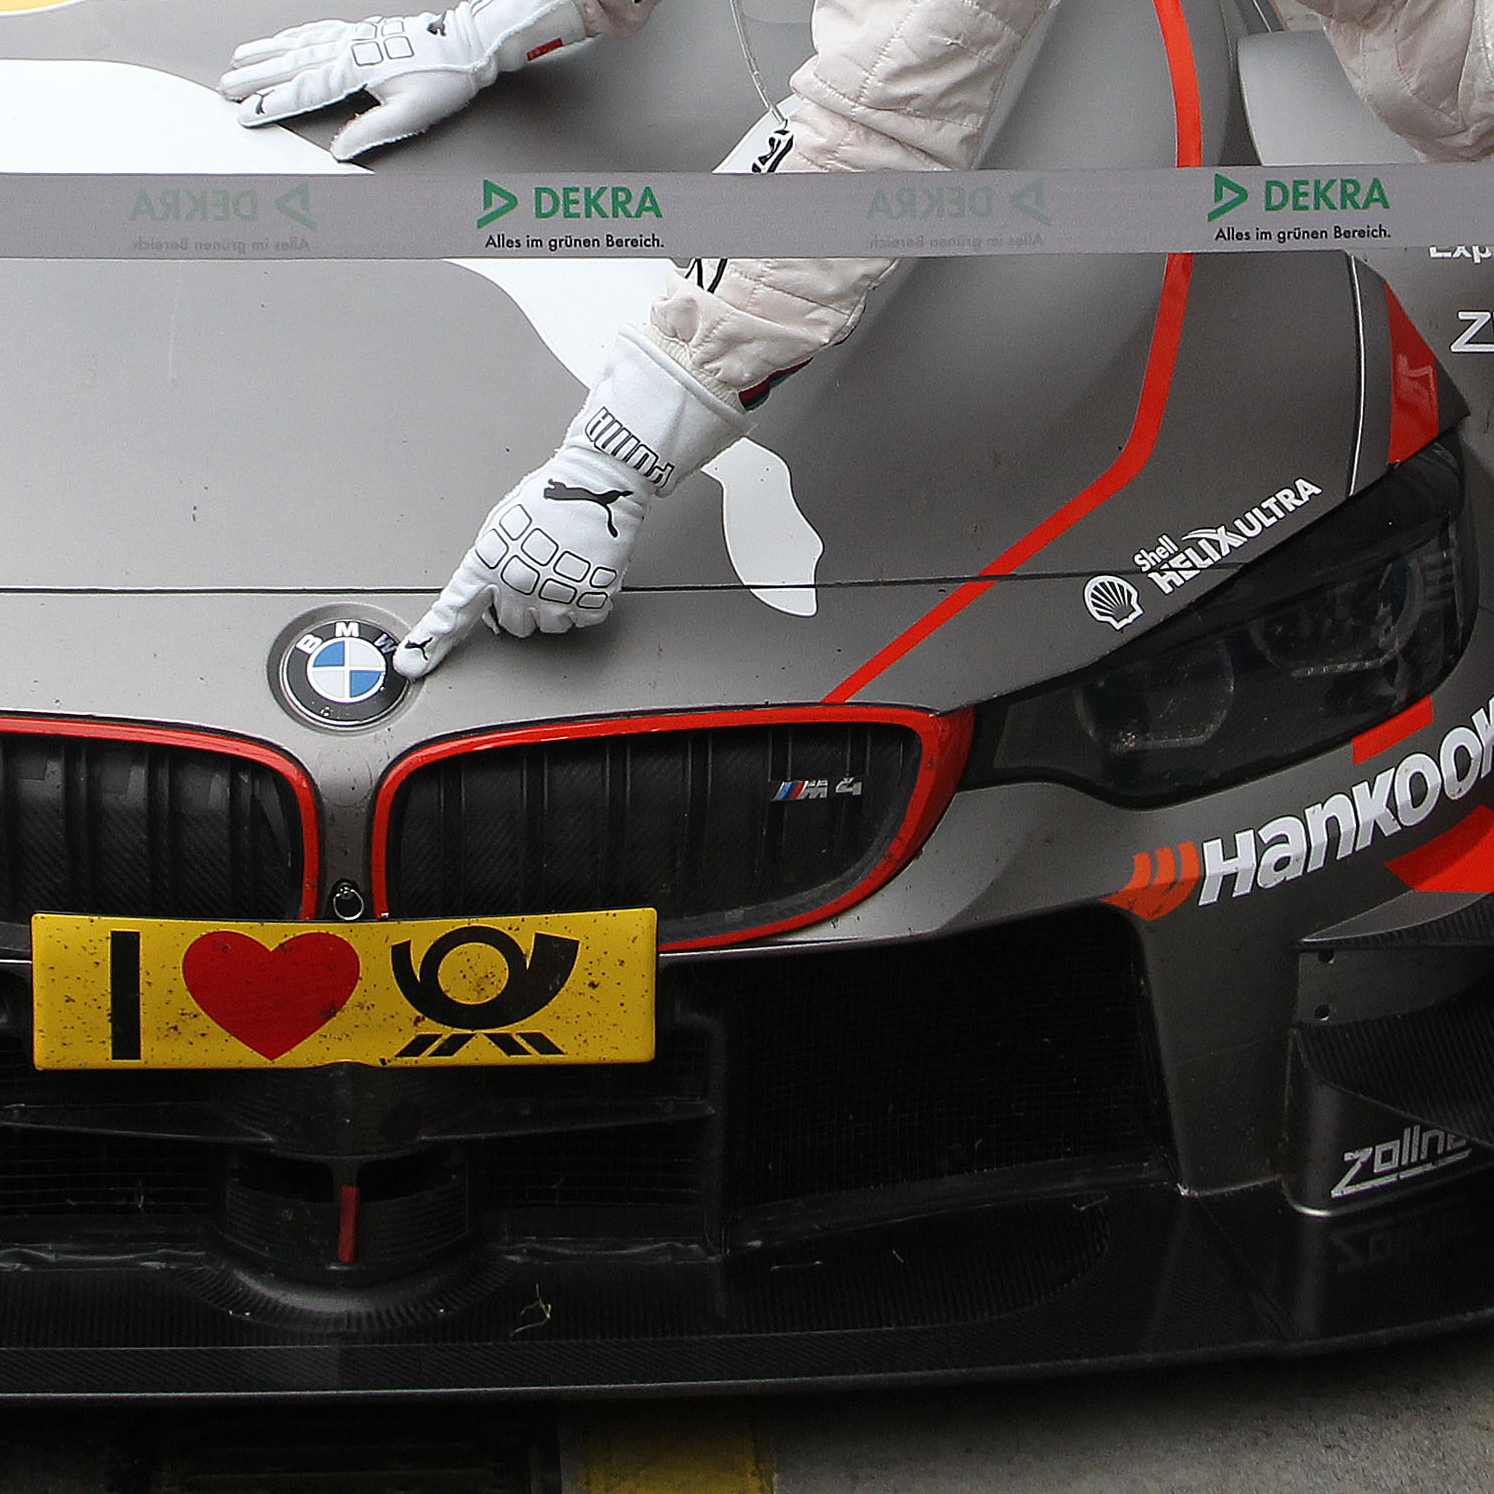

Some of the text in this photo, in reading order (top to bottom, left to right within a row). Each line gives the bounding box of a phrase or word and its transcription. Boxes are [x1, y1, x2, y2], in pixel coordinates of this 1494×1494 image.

[534, 186, 663, 219] DEKRA
[1265, 178, 1390, 211] DEKRA
[484, 233, 664, 252] Alles im grünen Bereich.
[1214, 224, 1391, 244] Alles im grünen Bereich.
[1132, 533, 1180, 573] Shell
[1147, 477, 1323, 595] HELIX ULTRA
[295, 620, 398, 656] BMW
[1330, 1123, 1470, 1200] Zolln
